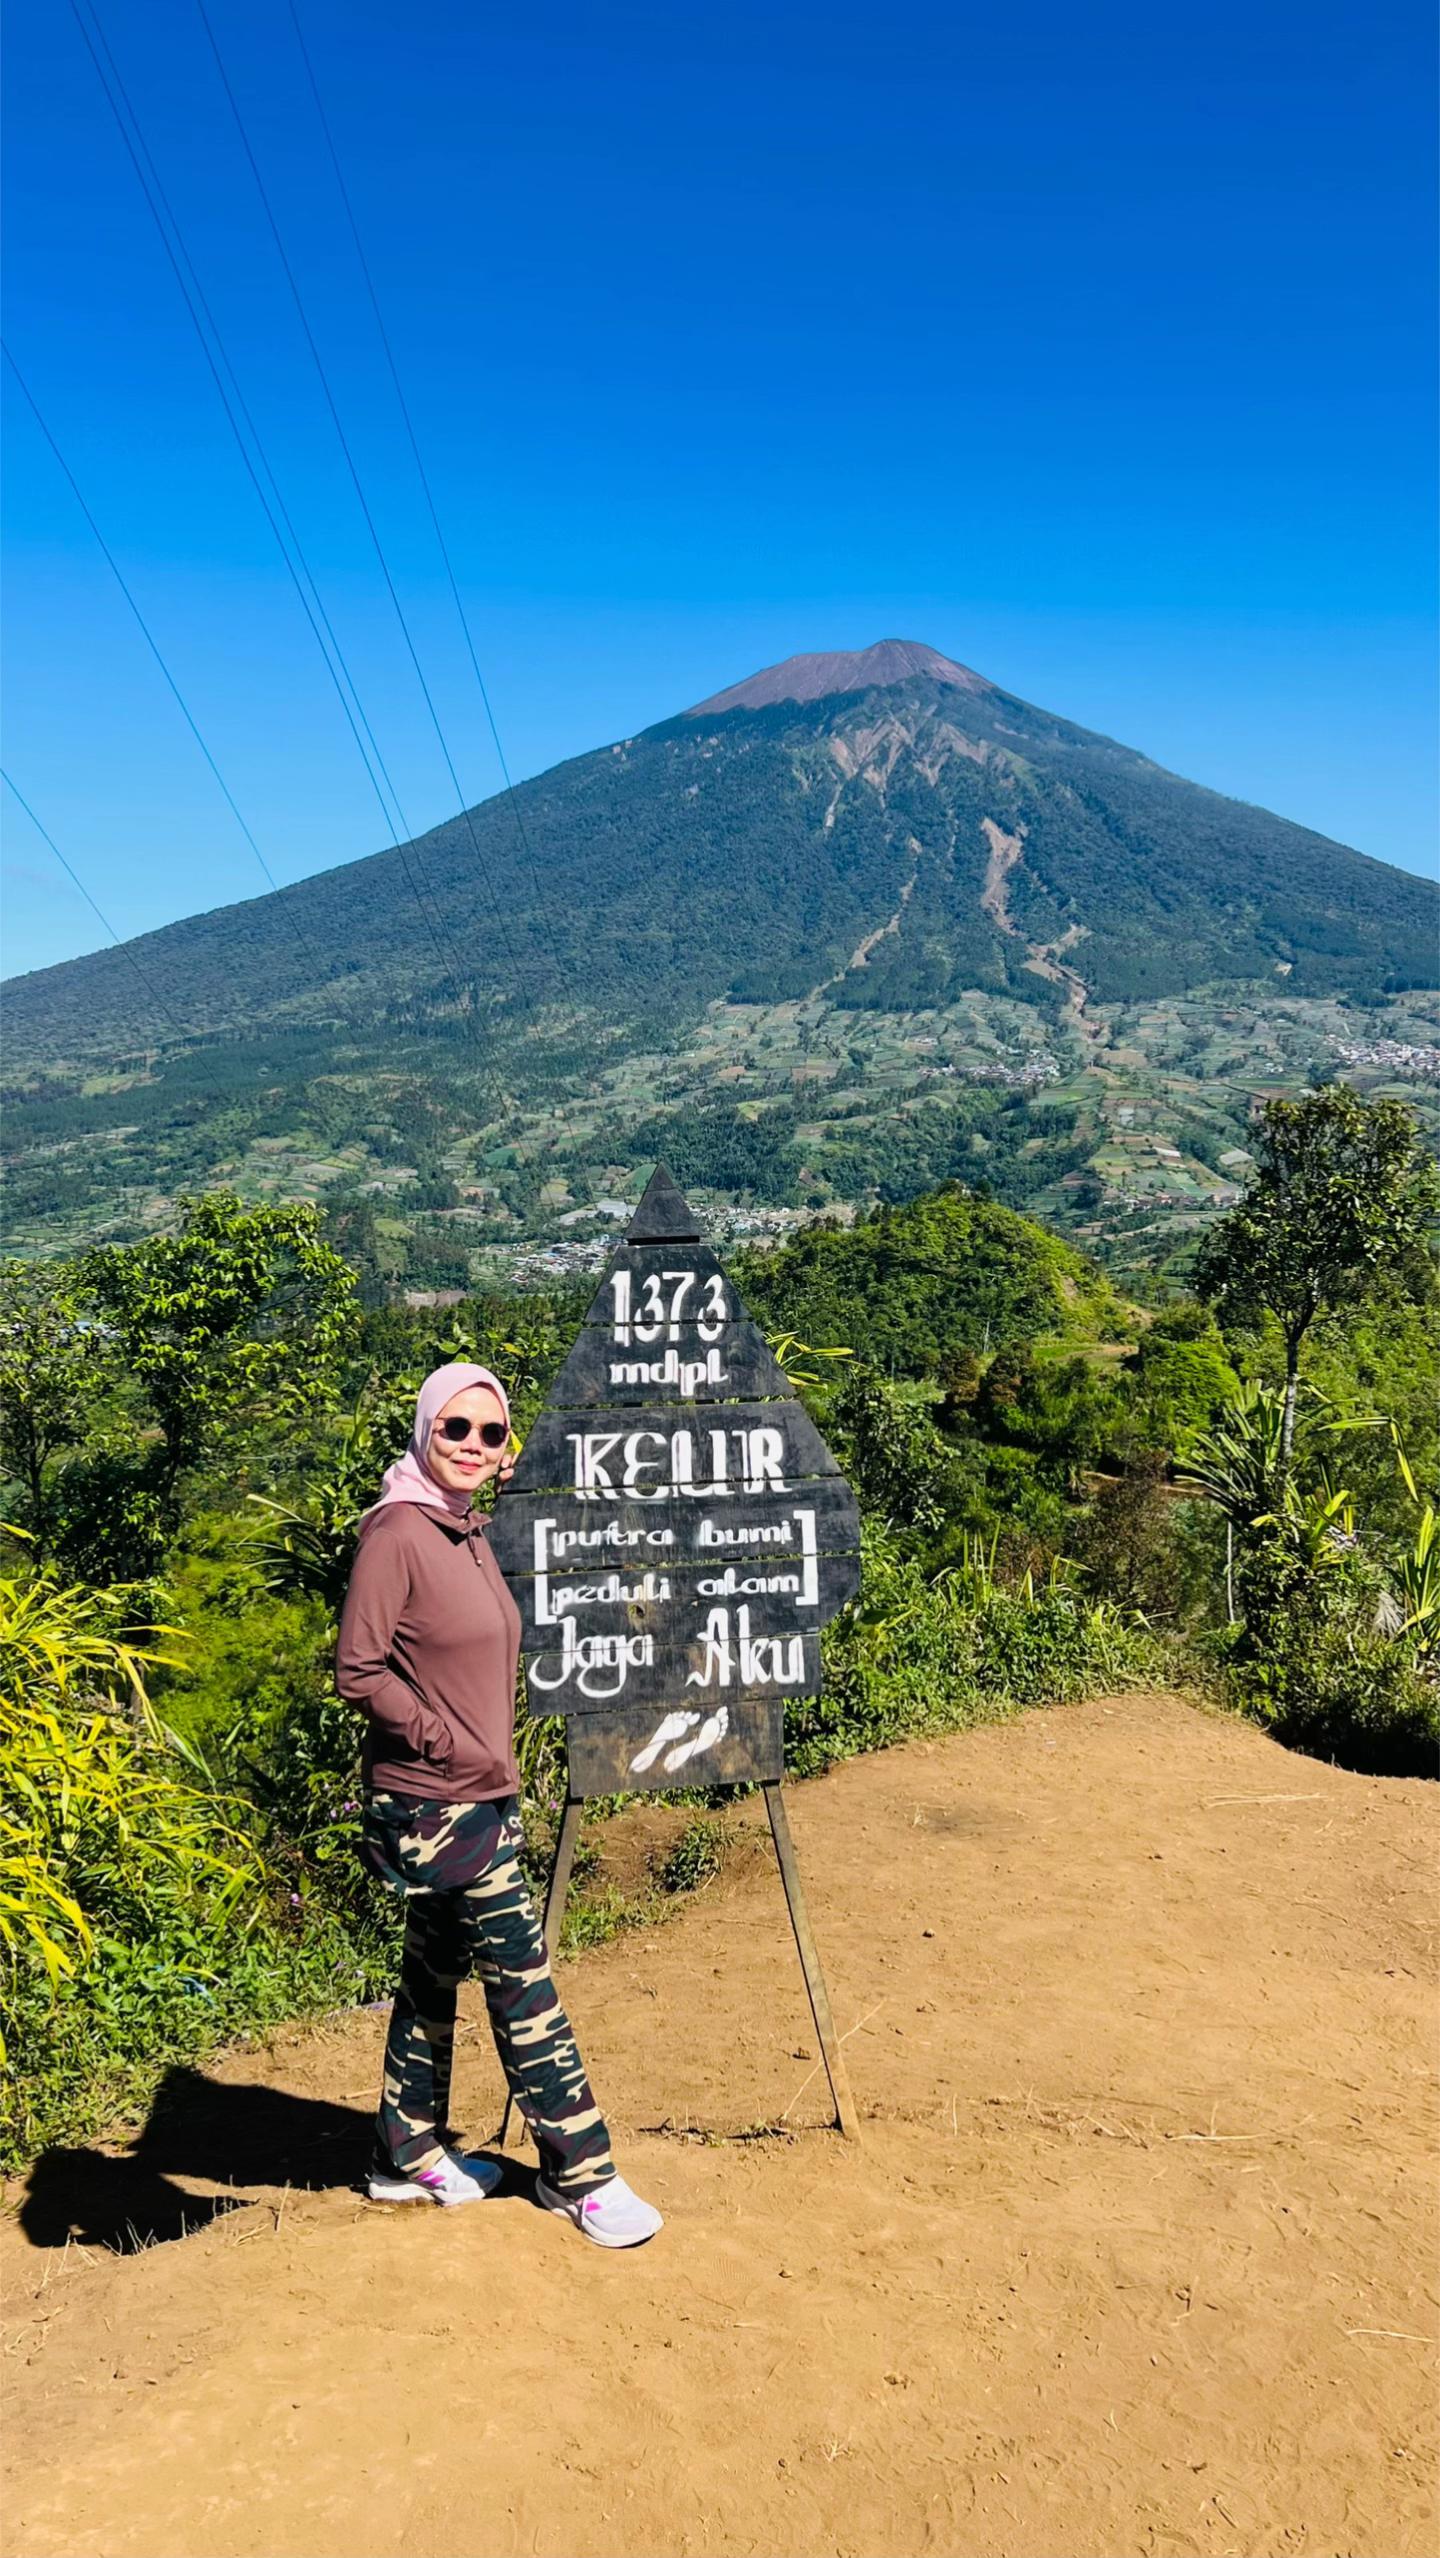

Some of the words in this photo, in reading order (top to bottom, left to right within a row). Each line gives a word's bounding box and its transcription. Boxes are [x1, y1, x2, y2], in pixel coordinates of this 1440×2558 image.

[609, 1348, 729, 1397] mdpl
[552, 1520, 674, 1557] putra
[699, 1519, 793, 1546] bumi
[551, 1573, 671, 1615] peduli
[697, 1567, 799, 1596] alam
[529, 1615, 654, 1698] Jaga
[685, 1603, 805, 1687] Aku
